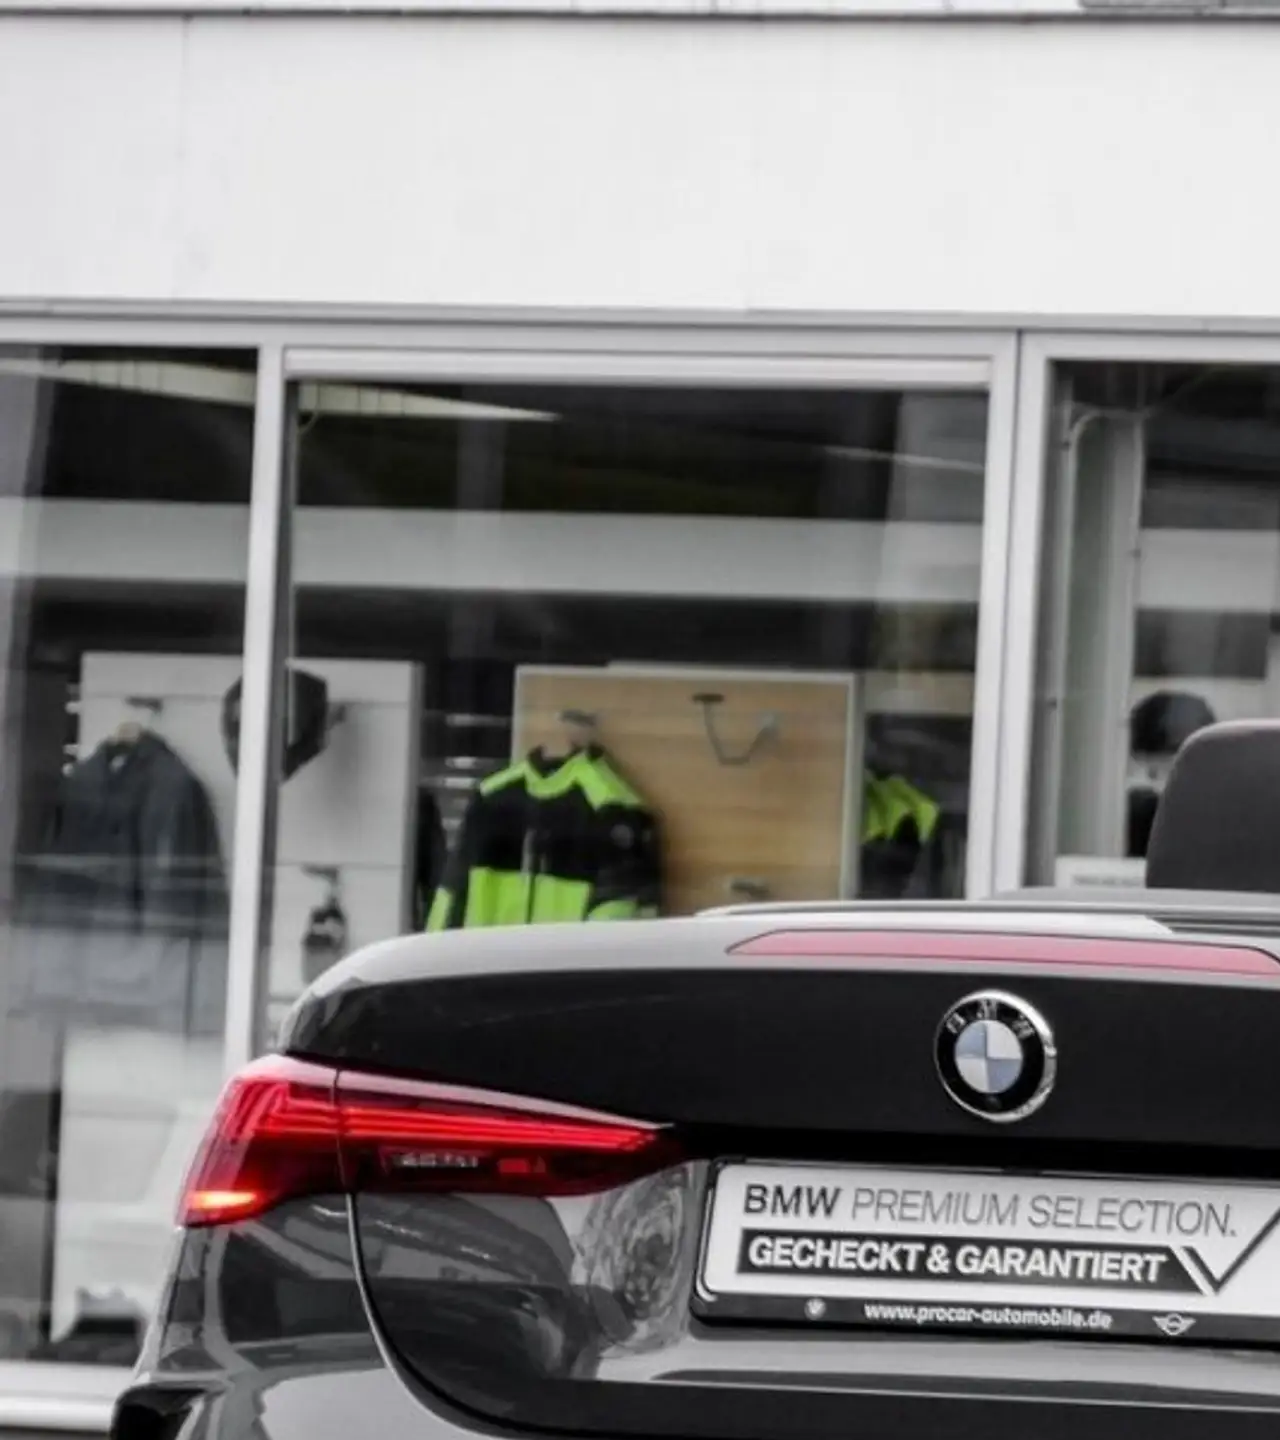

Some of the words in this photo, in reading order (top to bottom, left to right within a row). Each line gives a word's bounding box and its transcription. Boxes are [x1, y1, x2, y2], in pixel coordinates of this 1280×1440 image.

[743, 1183, 842, 1217] BMW
[851, 1187, 1020, 1227] PREMIUM
[748, 1235, 925, 1272] GECHECKT
[926, 1243, 950, 1274] &
[955, 1244, 1168, 1283] GARANTIERT
[863, 1303, 1113, 1330] www.procar-automobile.de
